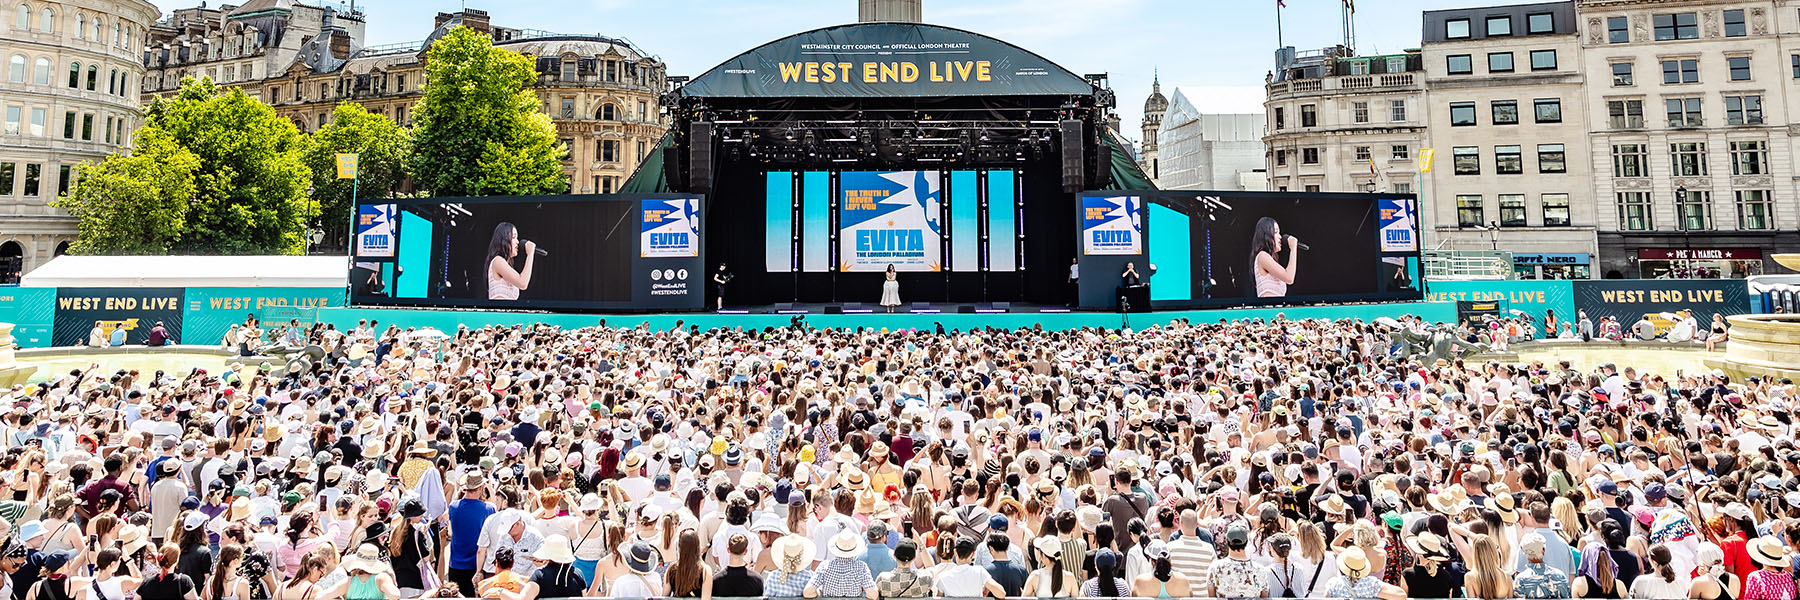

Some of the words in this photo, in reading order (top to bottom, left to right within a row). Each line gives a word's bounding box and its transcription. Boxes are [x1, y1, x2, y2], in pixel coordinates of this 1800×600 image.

[778, 61, 853, 83] WEST
[863, 62, 920, 83] END
[930, 60, 992, 82] LIVE
[363, 234, 388, 246] EVITA
[650, 232, 689, 245] EVITA
[856, 229, 924, 251] EVITA
[1092, 230, 1132, 242] EVITA
[1386, 229, 1410, 240] EVITA
[1676, 250, 1691, 258] PRE
[1698, 250, 1723, 258] MANGER
[1510, 291, 1546, 304] LIVE
[1601, 290, 1645, 303] WEST
[1650, 290, 1683, 303] END
[1688, 290, 1724, 302] LIVE
[59, 297, 101, 310] WEST
[105, 297, 137, 310] END
[142, 297, 178, 310] LIVE
[210, 297, 251, 310] WEST
